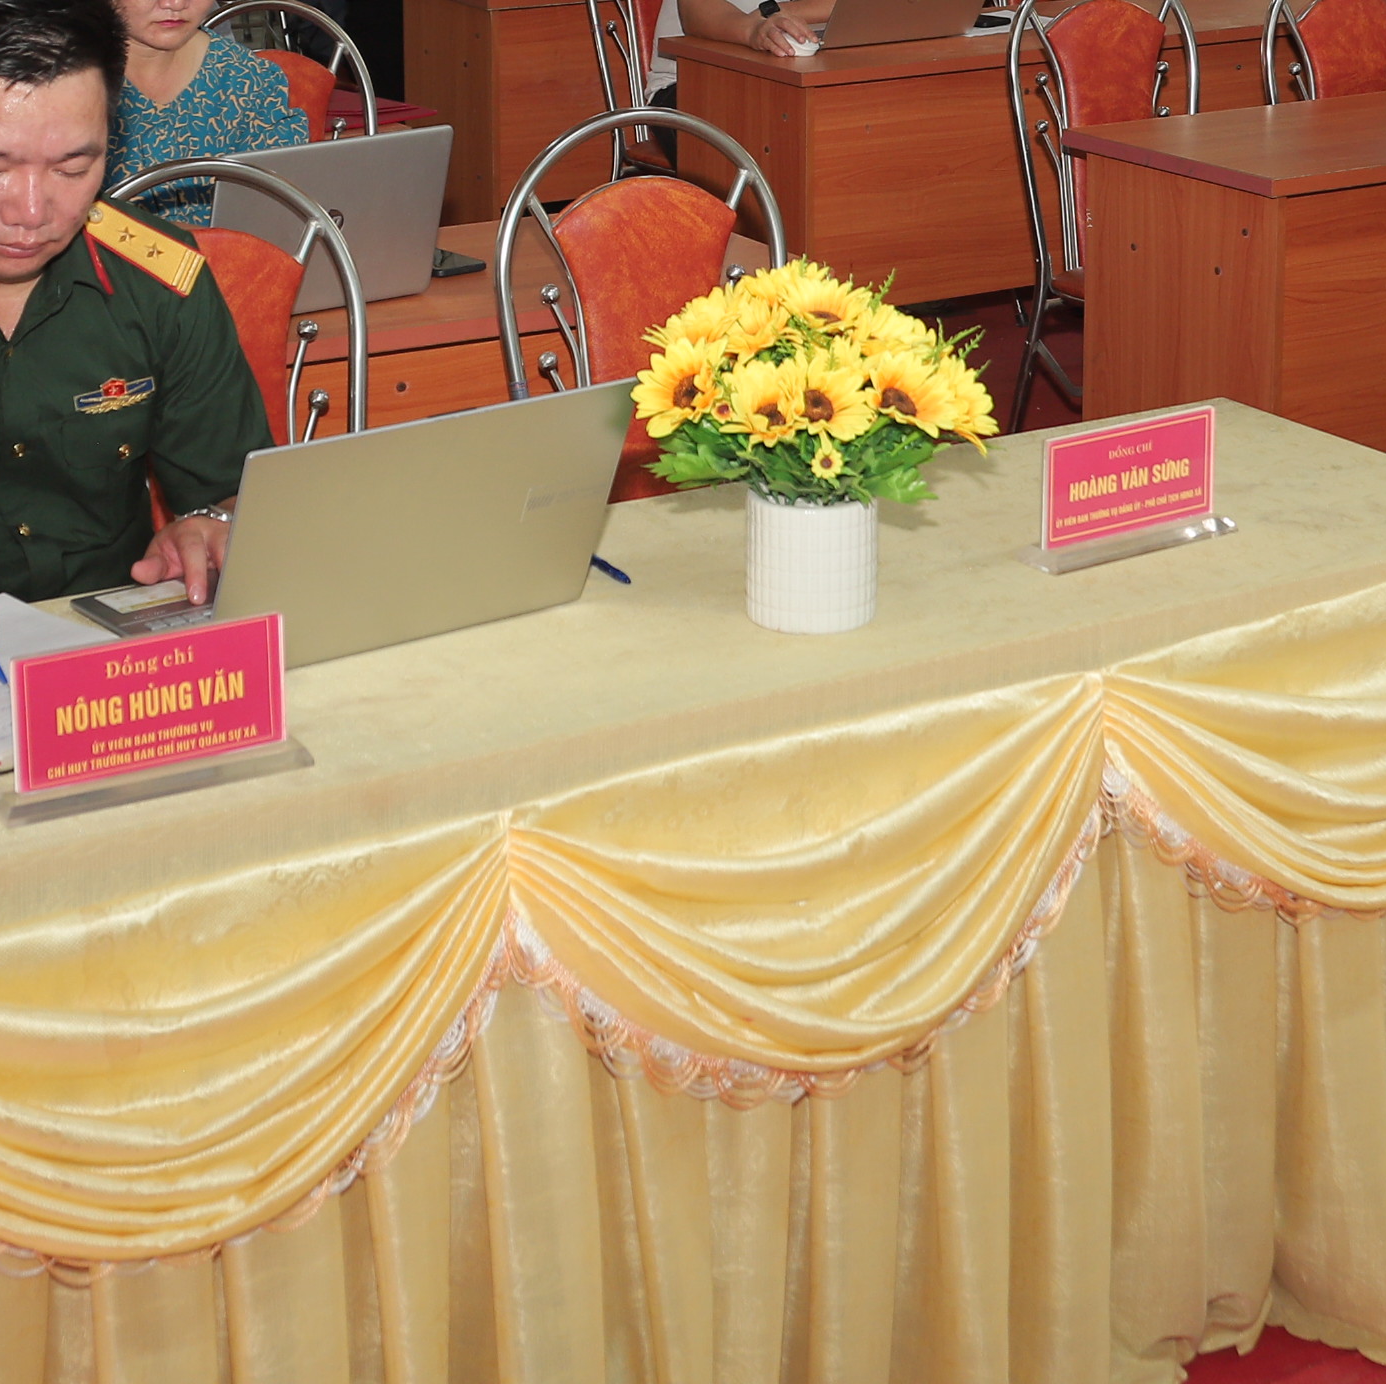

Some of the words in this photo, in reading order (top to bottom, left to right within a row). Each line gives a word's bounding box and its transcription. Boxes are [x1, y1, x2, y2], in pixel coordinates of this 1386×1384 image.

[1069, 474, 1117, 502] HOÀNG
[1121, 465, 1148, 490] VĂN
[106, 654, 158, 679] Đồng
[162, 645, 194, 667] chí
[56, 696, 124, 736] NÔNG
[129, 682, 193, 722] HÙNG
[198, 668, 244, 706] VĂN
[107, 737, 132, 752] VIÊN
[133, 731, 155, 746] BAN
[199, 720, 213, 733] VỤ
[67, 760, 88, 776] HUY
[133, 746, 155, 762] BAN
[176, 738, 196, 753] HUY
